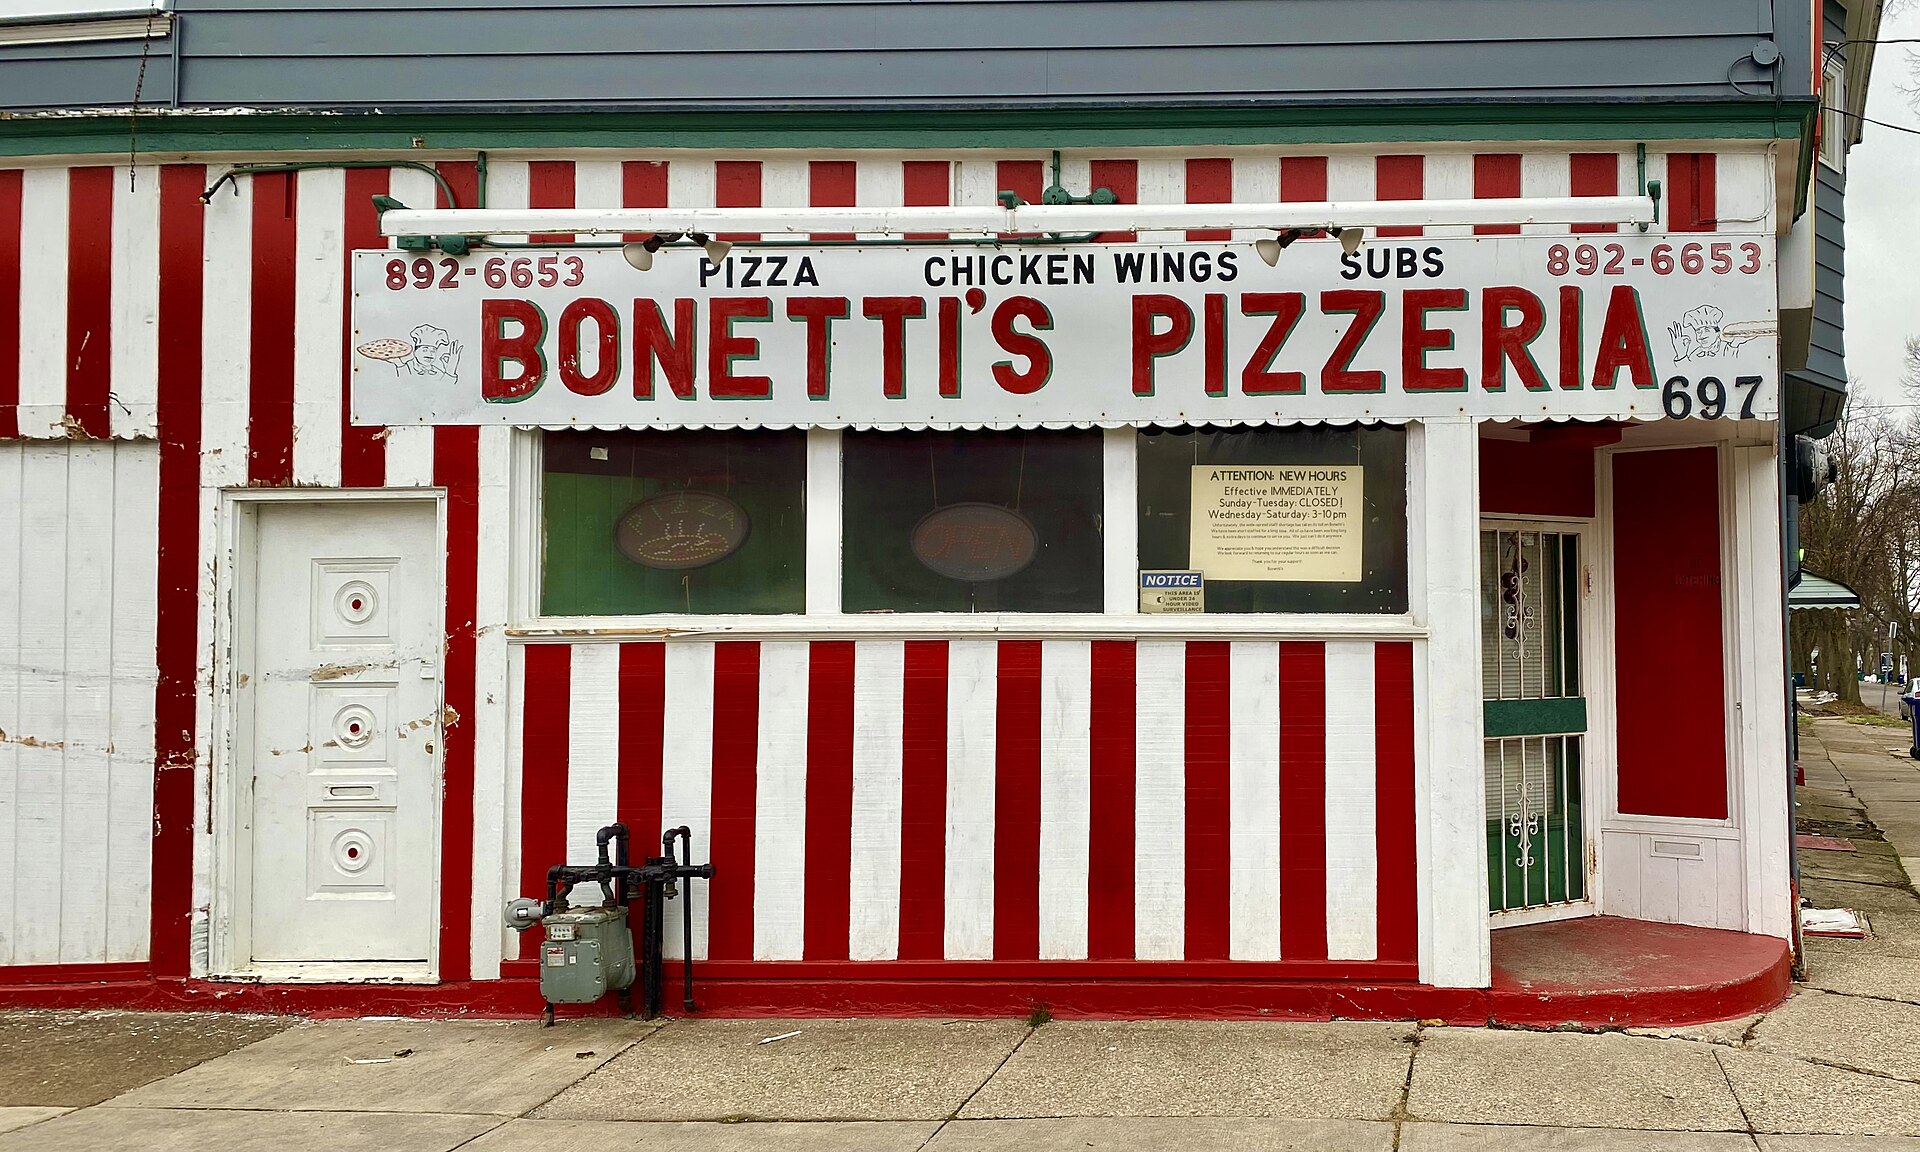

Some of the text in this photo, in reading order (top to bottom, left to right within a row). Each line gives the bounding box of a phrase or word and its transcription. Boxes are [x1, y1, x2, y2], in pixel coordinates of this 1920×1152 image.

[386, 256, 585, 291] 892-6653
[699, 255, 820, 288] PIZZA
[925, 251, 1240, 288] CHICKEN WINGS
[1340, 246, 1444, 280] SUBS
[1546, 242, 1762, 276] 892-6653
[481, 284, 1659, 403] BONETTI'S PIZZERIA
[1662, 375, 1764, 420] 697
[1210, 470, 1347, 481] ATTENTION: NEW HOURS
[1224, 486, 1339, 496] Effective IMMEDIATELY
[1208, 509, 1310, 520] Wednesday-Saturday:
[1219, 497, 1343, 509] Sunday-Tuesday: CLOSED!
[919, 524, 1024, 559] OPEN
[1146, 575, 1198, 586] NOTICE
